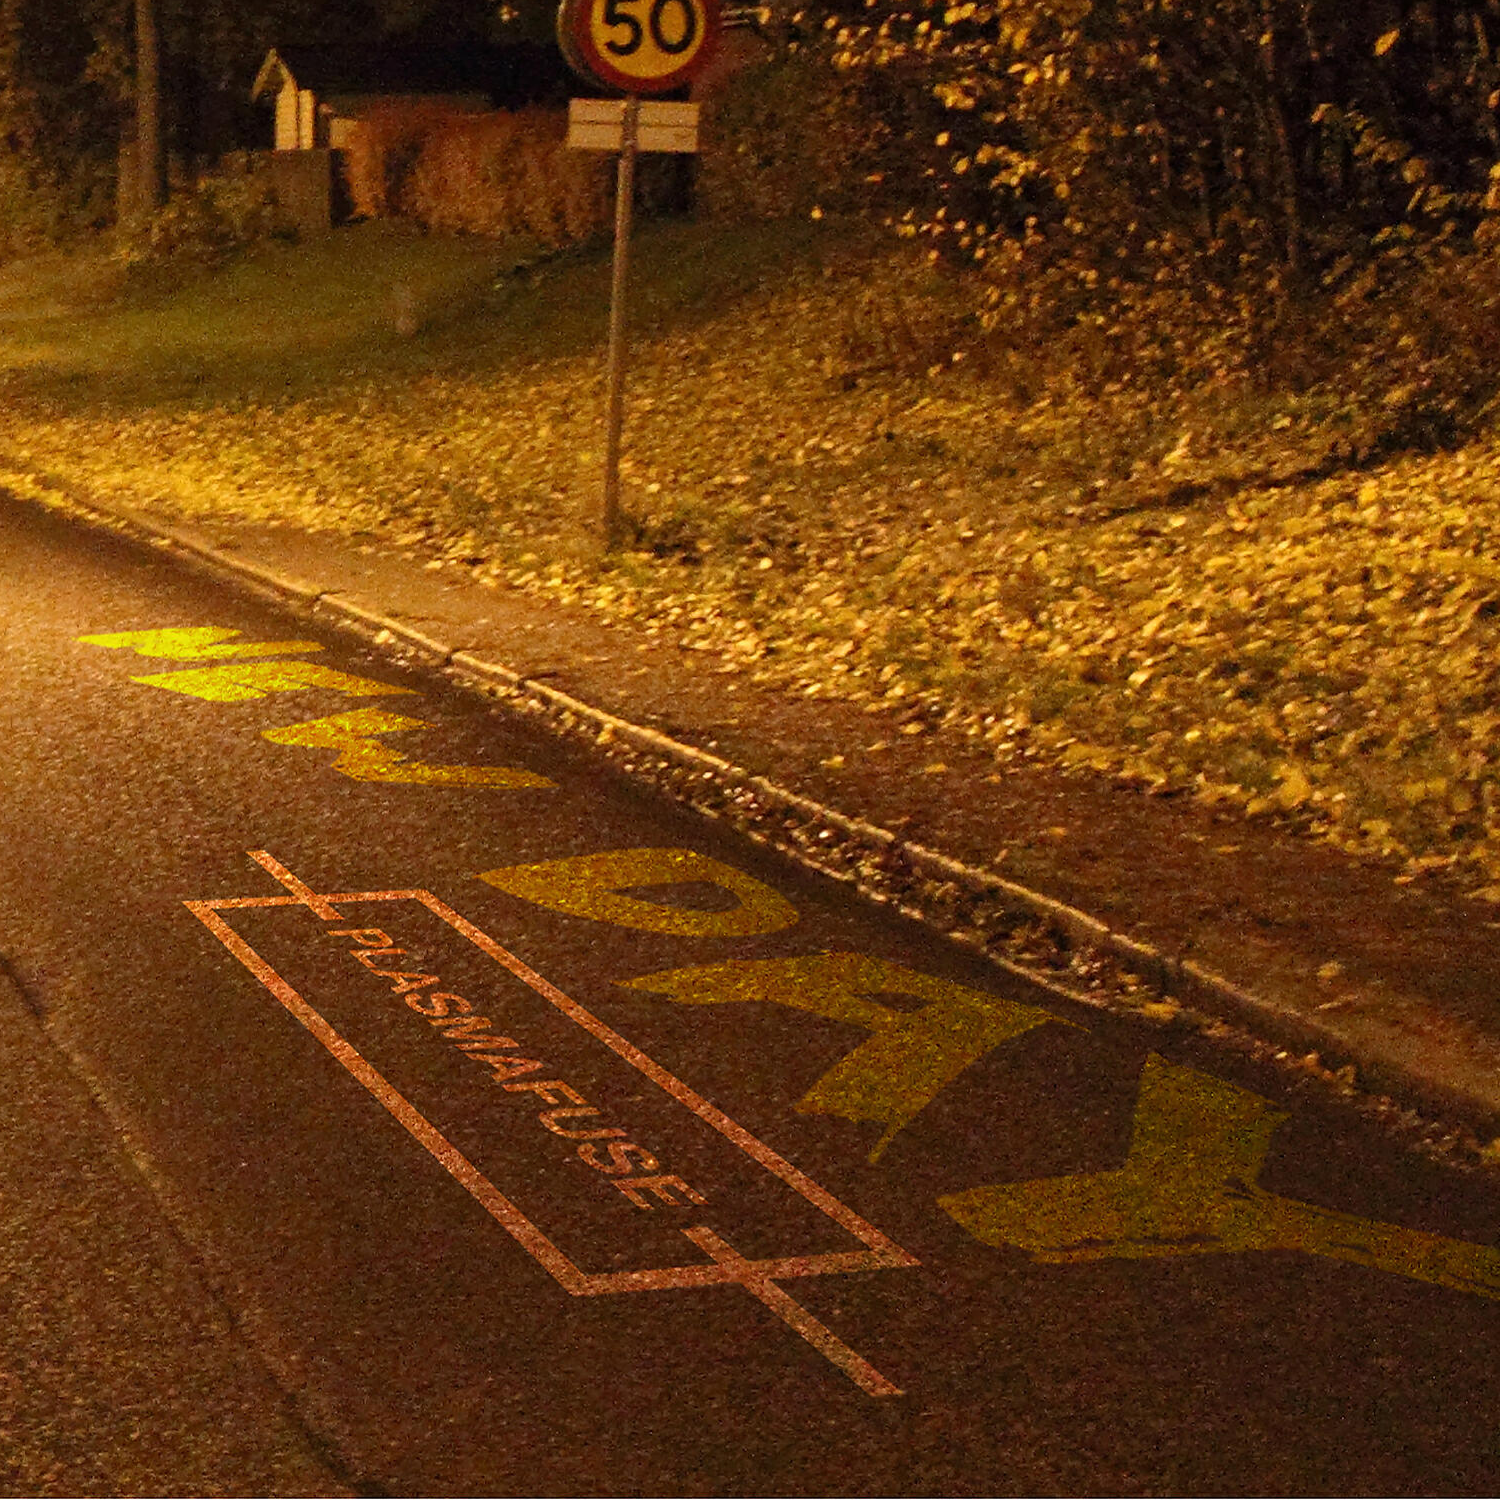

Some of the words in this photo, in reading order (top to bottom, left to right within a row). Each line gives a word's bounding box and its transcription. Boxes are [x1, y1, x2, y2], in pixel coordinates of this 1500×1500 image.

[74, 625, 560, 789] NEW
[474, 848, 1500, 1301] DAY
[327, 928, 709, 1210] PLASMAFUSE
